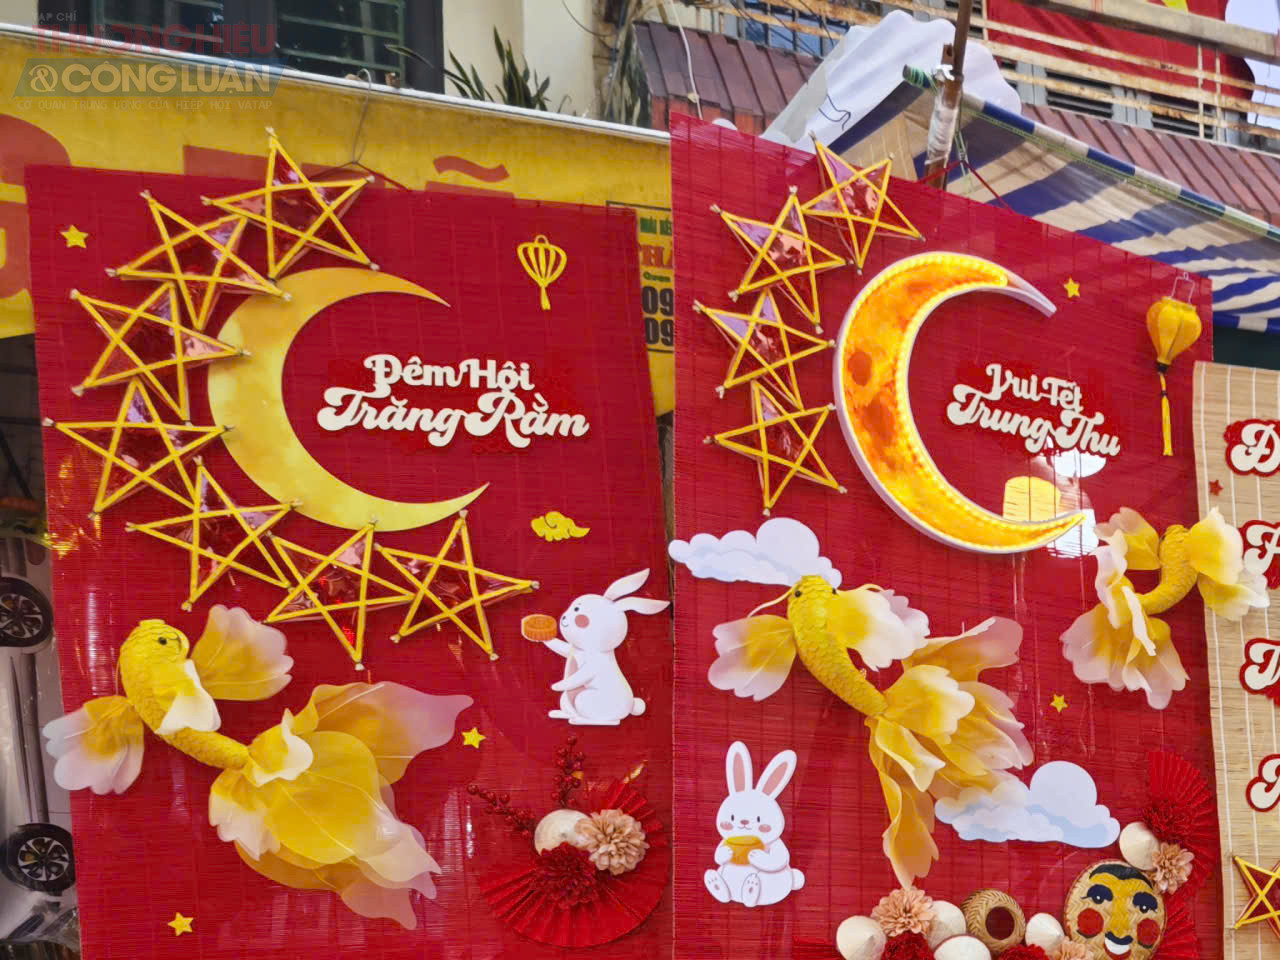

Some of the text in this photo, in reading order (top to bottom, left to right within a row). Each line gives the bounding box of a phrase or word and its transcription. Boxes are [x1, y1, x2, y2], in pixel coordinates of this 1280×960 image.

[363, 354, 535, 397] Đêm Hội
[1042, 376, 1084, 412] Tết
[317, 386, 590, 448] Trăng Rằm
[947, 383, 1121, 456] Trung Thu
